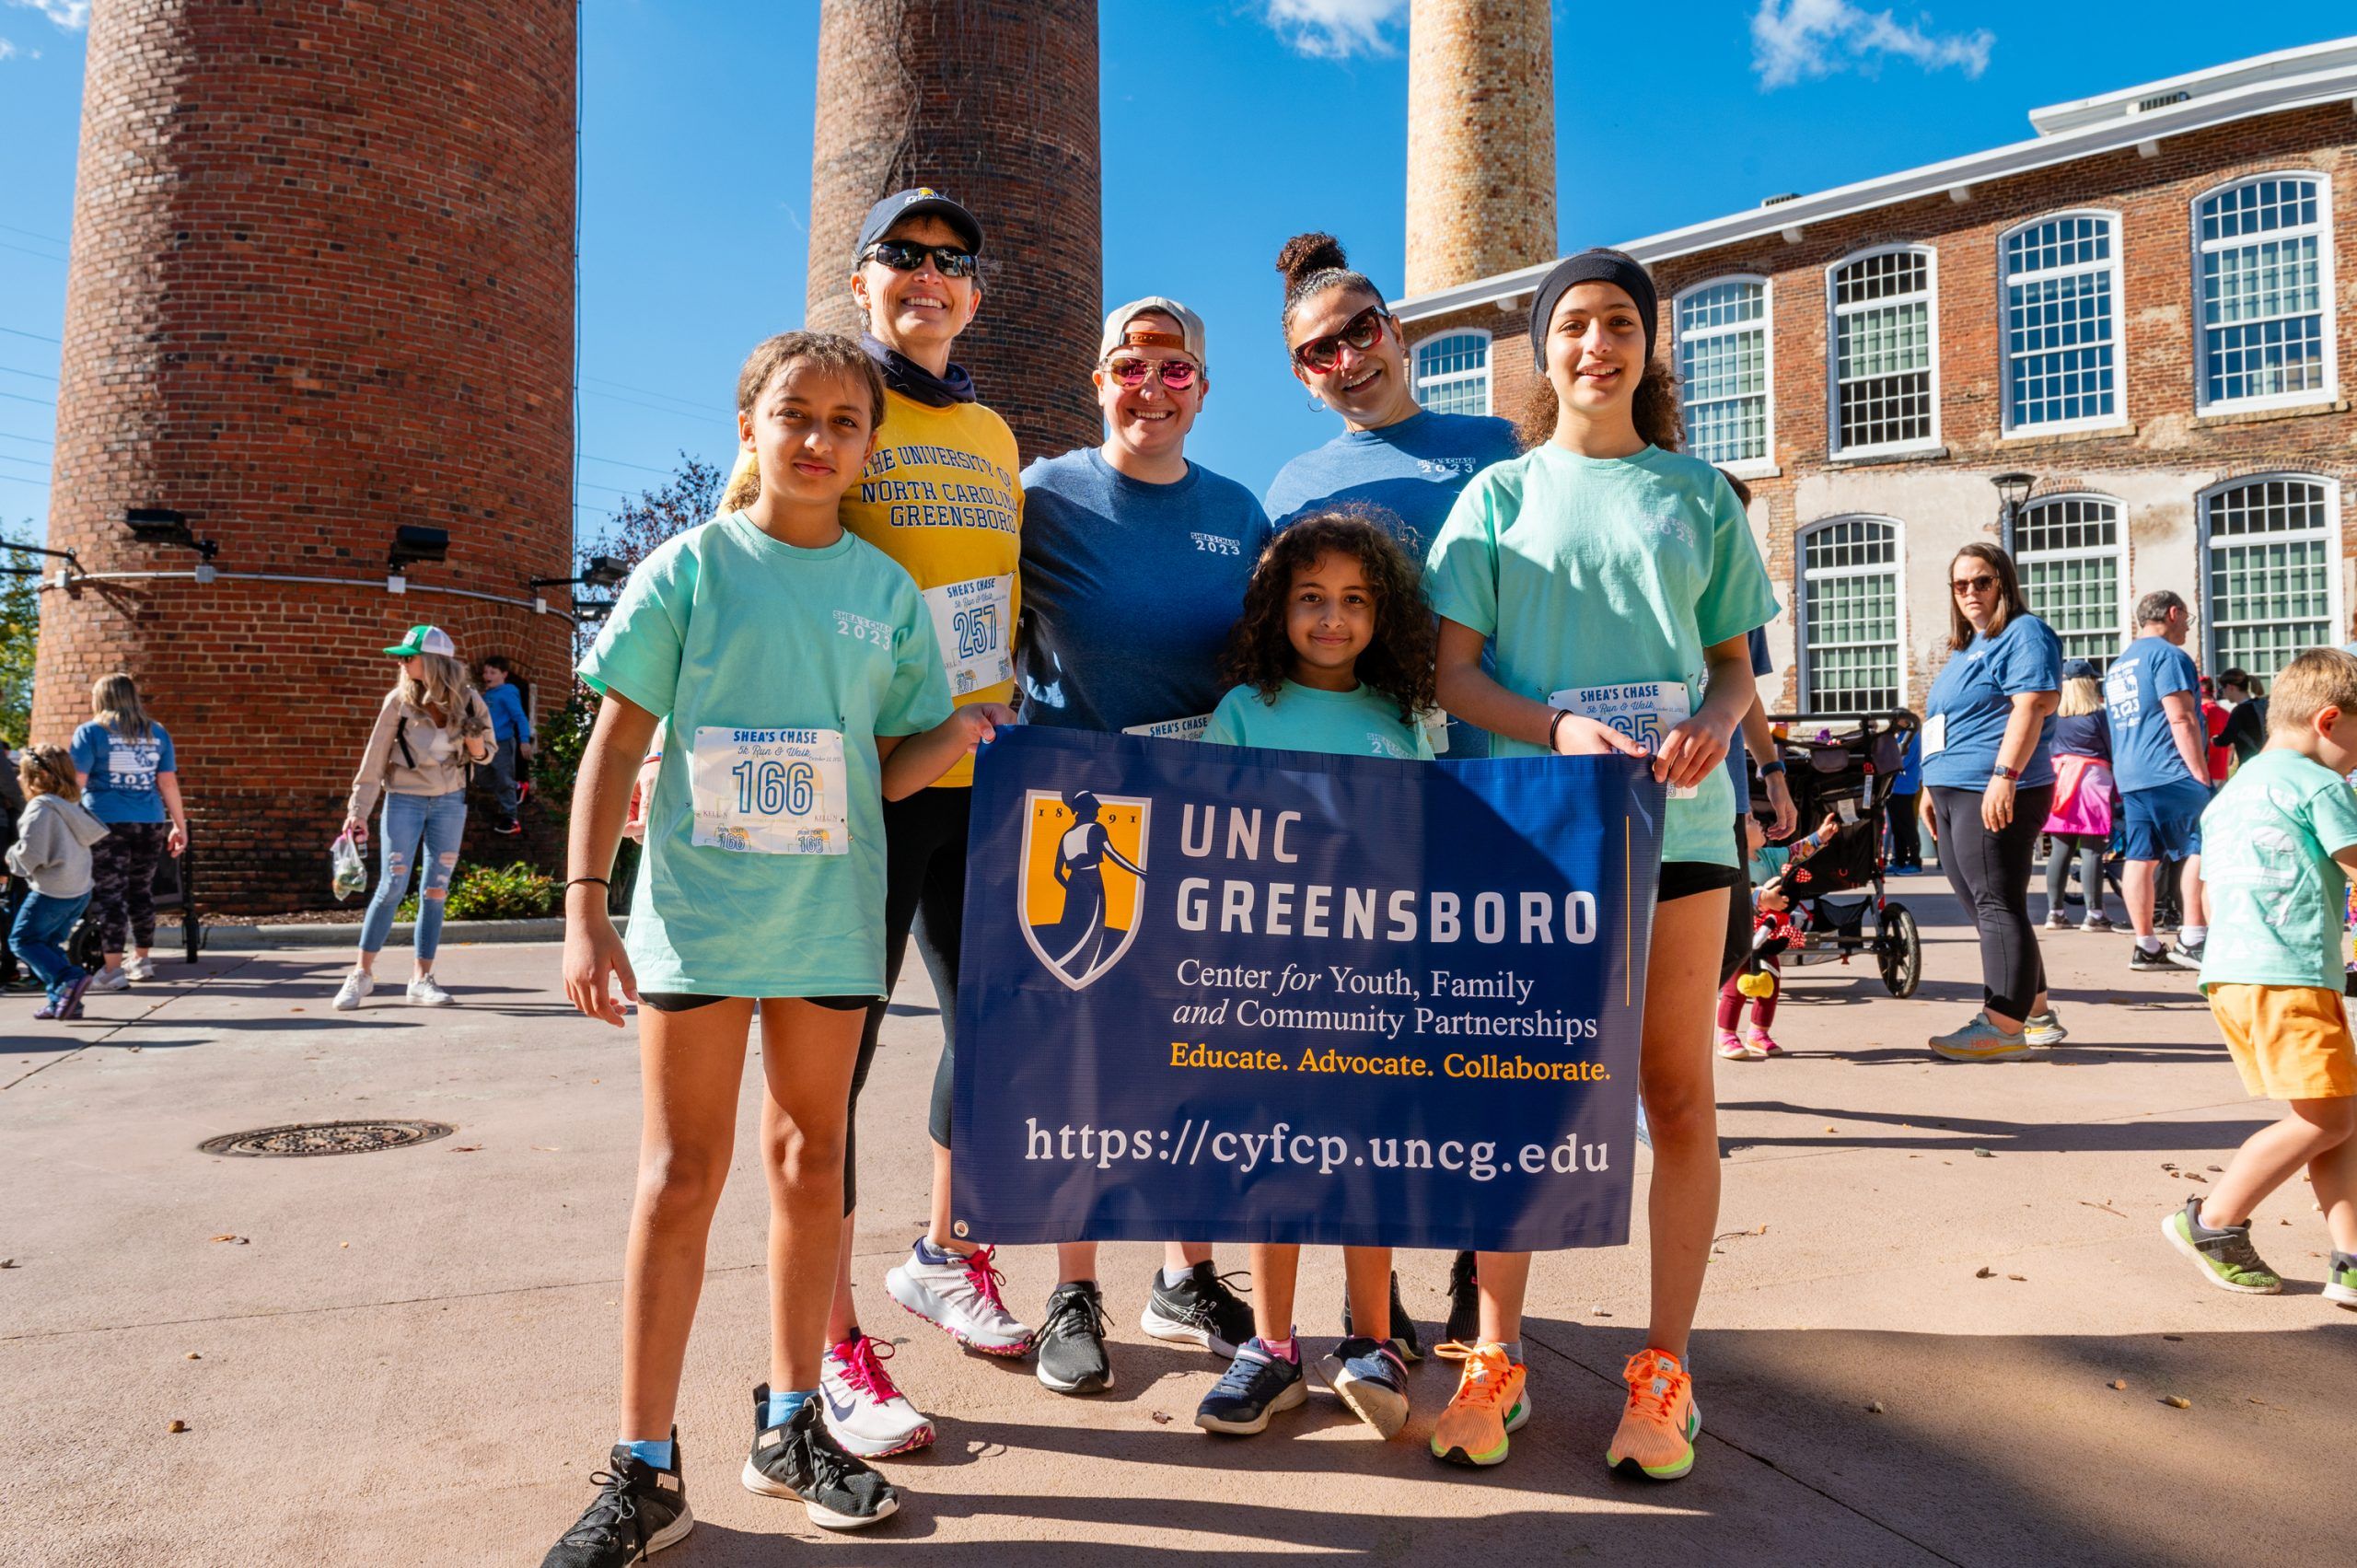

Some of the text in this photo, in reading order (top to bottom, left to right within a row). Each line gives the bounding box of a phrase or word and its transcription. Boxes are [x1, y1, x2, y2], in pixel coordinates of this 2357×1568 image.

[898, 446, 994, 477] UNIVERSITY
[997, 467, 1012, 492] O
[1422, 464, 1473, 473] 2023
[861, 481, 938, 504] NORTH
[890, 505, 1016, 534] GREENSBORO
[1195, 540, 1240, 555] 2023
[946, 582, 975, 598] SHEA'S
[976, 577, 996, 592] CHASE
[837, 620, 890, 651] 2023
[953, 603, 996, 659] 257
[1581, 684, 1659, 703] SHEA'S CHASE
[1599, 703, 1618, 714] Run
[1631, 701, 1655, 711] Walk
[734, 730, 818, 744] SHEA'S CHASE
[1150, 717, 1208, 738] SHEA'S CHASE
[1595, 713, 1661, 755] 65
[737, 745, 749, 755] 5k
[752, 744, 772, 758] Run
[774, 746, 784, 756] &
[785, 747, 811, 758] Walk
[732, 760, 814, 816] 166
[719, 833, 745, 852] 166
[798, 835, 823, 854] 166
[1180, 803, 1302, 864] UNC
[1177, 877, 1596, 945] GREENSBORO
[1177, 958, 1536, 1005] Center for Youth, Family
[1172, 998, 1597, 1045] and Community Partnerships
[1170, 1041, 1612, 1082] Educate. Advocate. Collaborate.
[1024, 1117, 1610, 1181] https://cyfcp.uncg.edu
